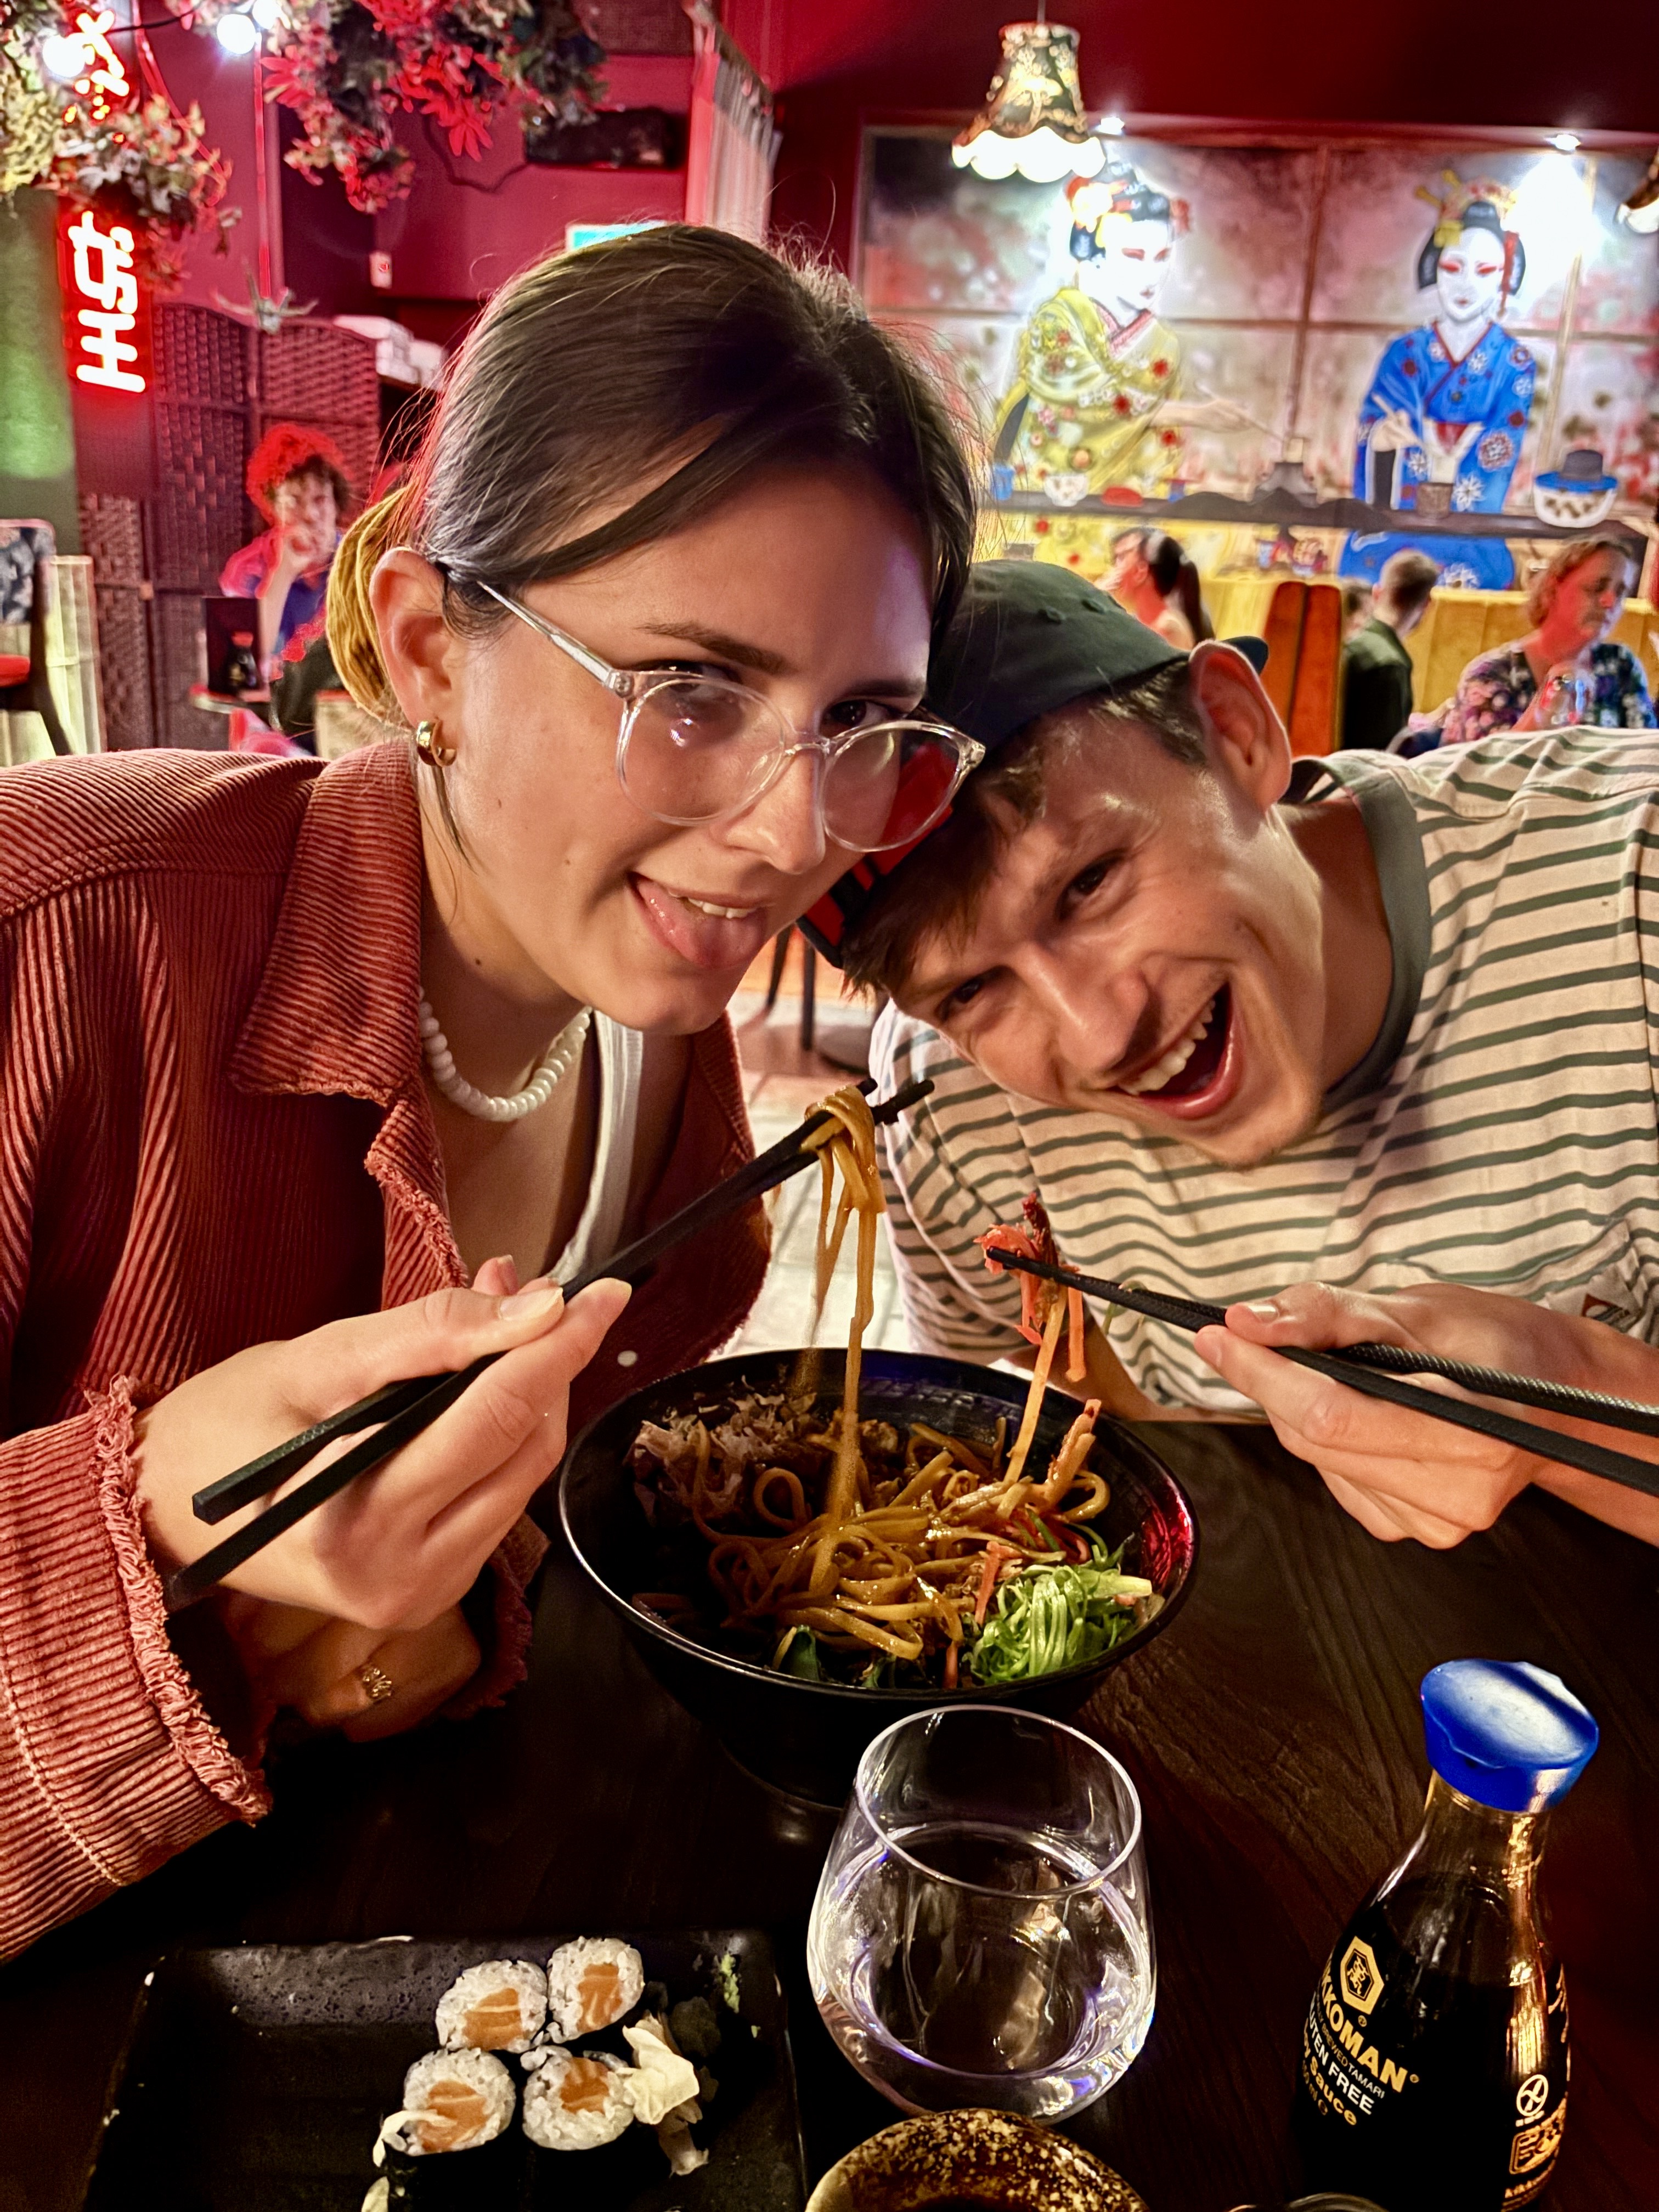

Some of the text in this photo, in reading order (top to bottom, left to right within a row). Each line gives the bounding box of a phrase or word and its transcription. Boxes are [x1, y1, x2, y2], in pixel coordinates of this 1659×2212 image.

[1310, 2056, 1357, 2126] Sauce
[1328, 2061, 1375, 2115] FREE
[1348, 2062, 1385, 2099] TAMARI
